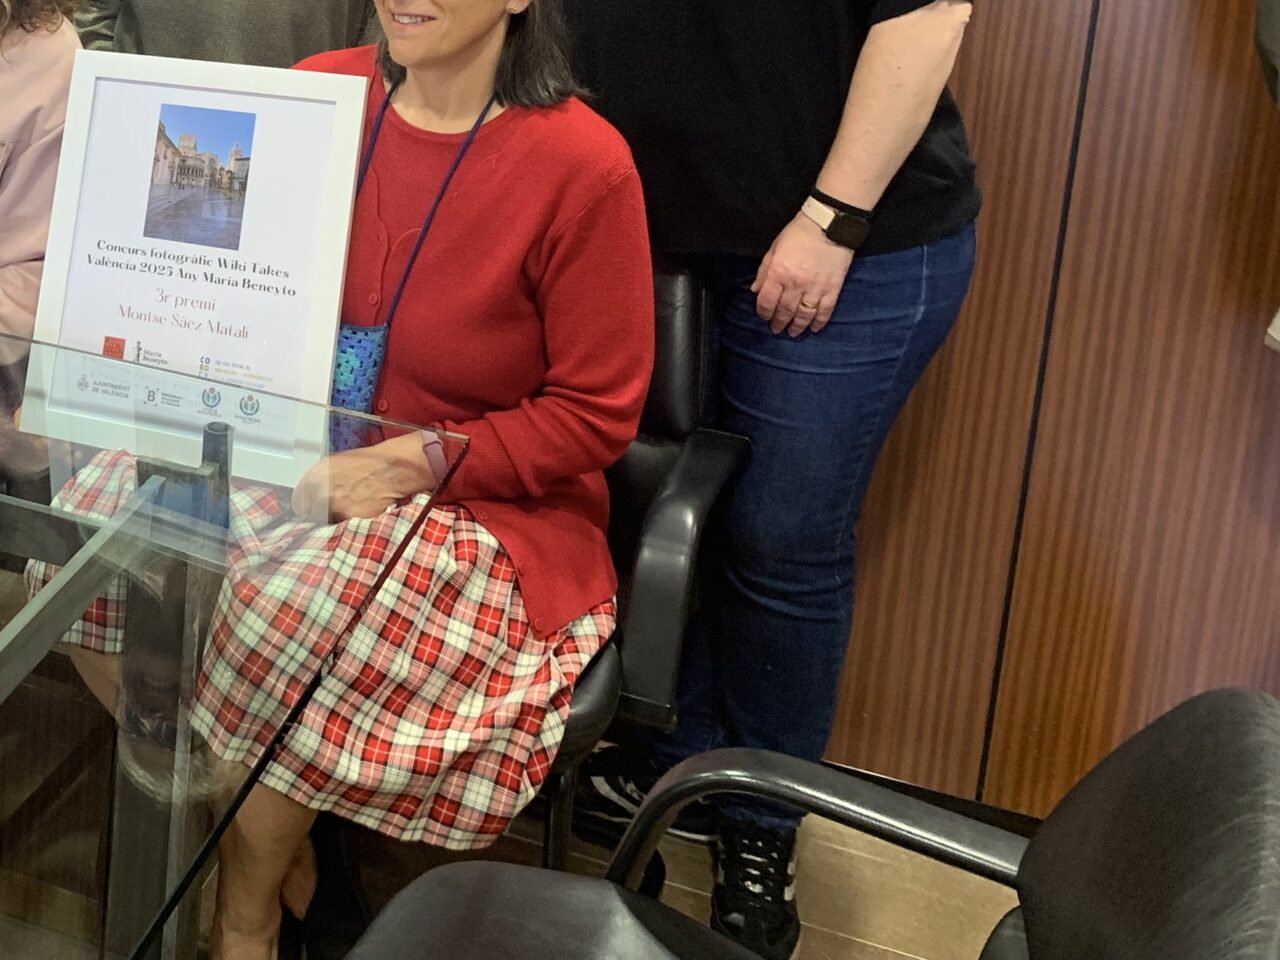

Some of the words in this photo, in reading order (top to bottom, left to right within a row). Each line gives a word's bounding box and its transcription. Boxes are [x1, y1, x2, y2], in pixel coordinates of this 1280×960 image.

[97, 239, 147, 256] Concurs
[150, 247, 214, 267] fotogràfic
[218, 257, 247, 272] Wiki
[251, 262, 290, 279] Takes
[87, 253, 137, 271] València
[139, 261, 174, 277] 2025
[177, 268, 199, 283] Any
[202, 271, 239, 287] Maria
[241, 278, 297, 296] Beneyto
[154, 287, 171, 303] 3r
[174, 295, 216, 312] premi
[119, 304, 167, 326] Montse
[143, 355, 168, 366] Beneyto
[144, 349, 162, 358] Maria
[147, 390, 156, 402] B
